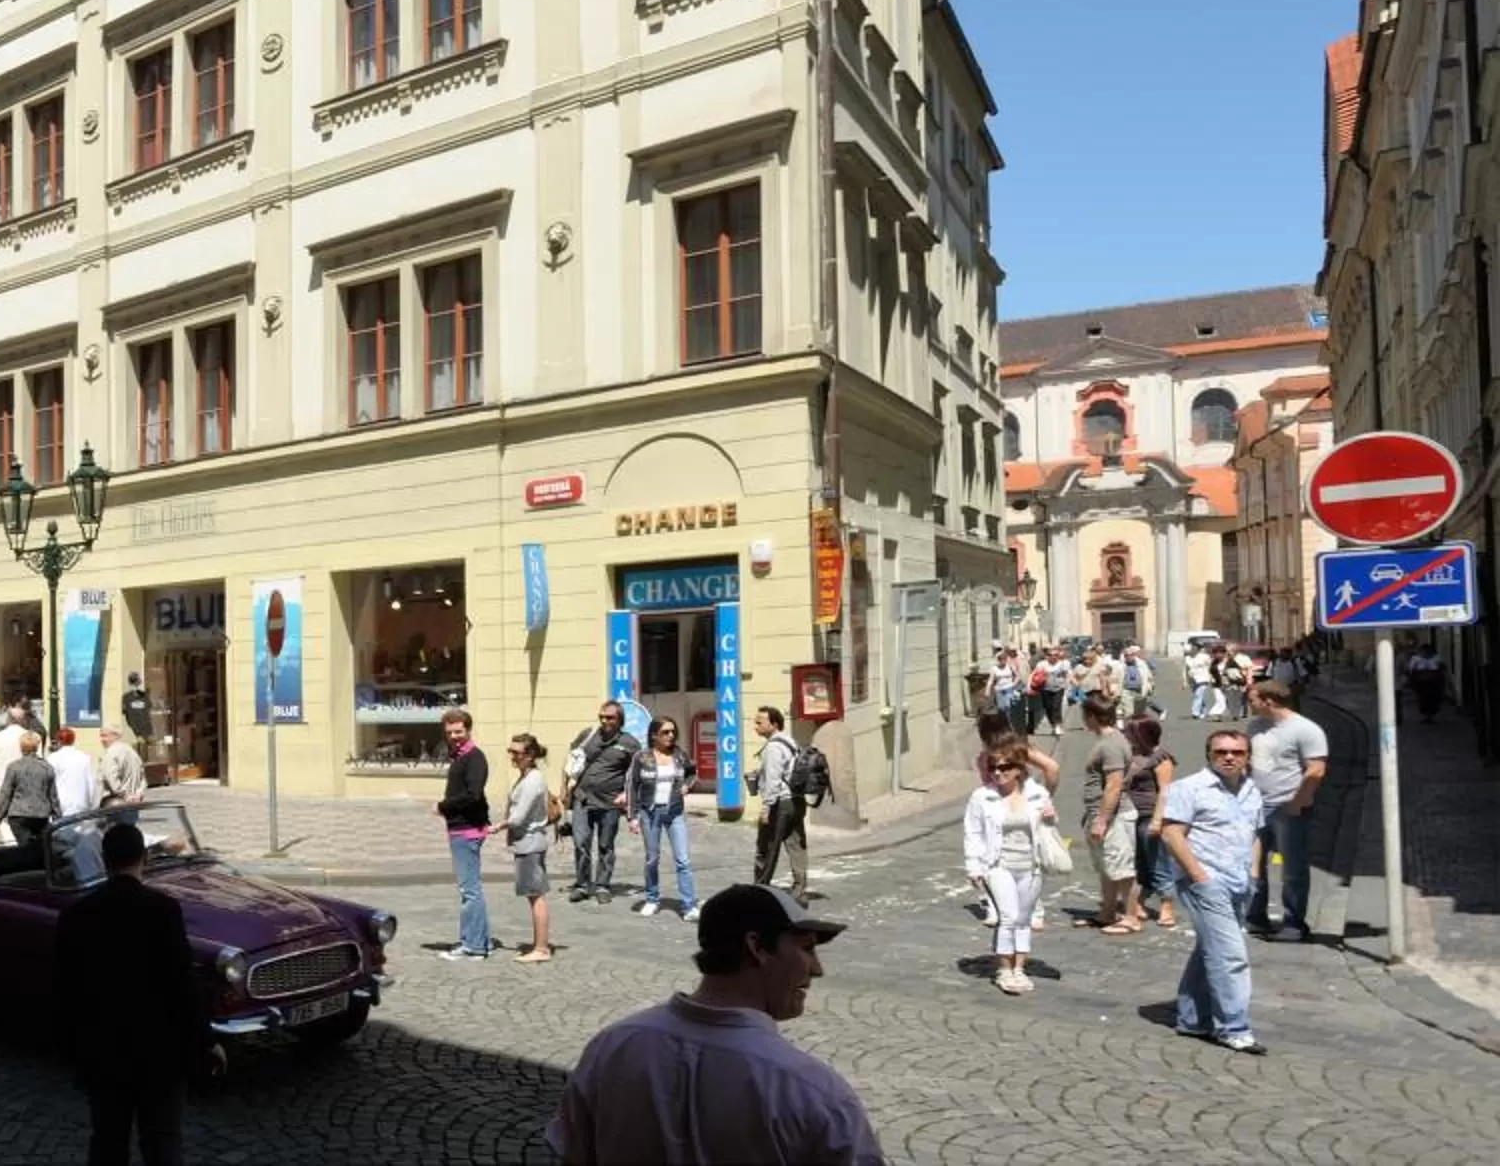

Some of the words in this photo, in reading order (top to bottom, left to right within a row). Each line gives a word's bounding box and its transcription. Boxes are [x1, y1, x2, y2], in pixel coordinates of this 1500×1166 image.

[615, 502, 738, 537] CHANGE
[81, 591, 107, 605] BLUE
[627, 573, 740, 606] CHANGE
[155, 593, 224, 631] BLU
[273, 706, 299, 716] BLUE
[720, 633, 736, 779] CHANGE
